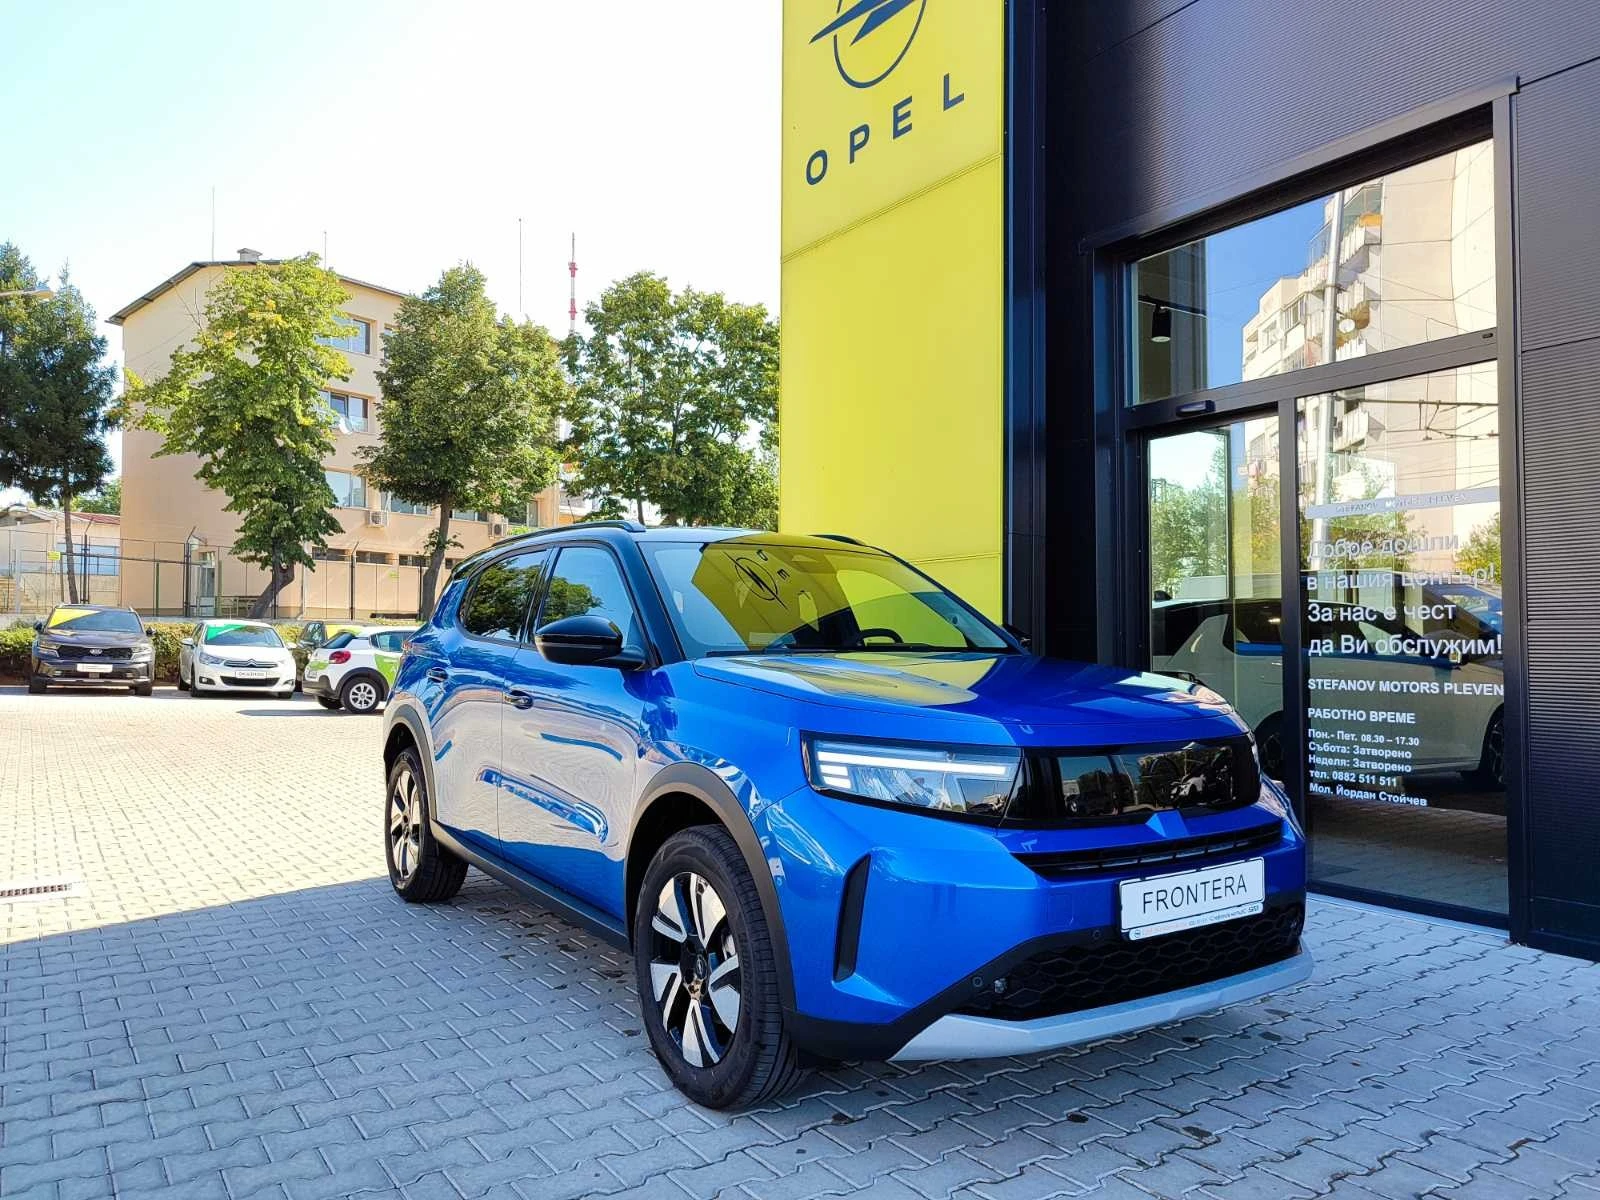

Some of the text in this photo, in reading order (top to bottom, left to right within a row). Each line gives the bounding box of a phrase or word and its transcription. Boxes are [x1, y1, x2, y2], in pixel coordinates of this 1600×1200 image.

[805, 72, 965, 185] OPEL
[1307, 535, 1459, 561] Добре дошли
[1307, 576, 1317, 590] в
[1325, 571, 1393, 590] нашия
[1308, 603, 1457, 622] За нас е чест
[1308, 633, 1502, 659] да Ви обслужим!
[1308, 678, 1504, 696] STEFANOV MOTORS PLEVEN
[1308, 707, 1416, 724] РАБОТНО ВРЕМЕ
[1337, 731, 1358, 741] Пет.
[1361, 734, 1385, 743] 08.30
[1395, 737, 1419, 746] 17.30
[1308, 742, 1412, 759] Събота: Затворено
[1308, 754, 1412, 772] Неделя: Затворено
[1309, 770, 1397, 787] тел. 0882 511 511
[1336, 784, 1376, 800] Йордан
[1379, 792, 1428, 806] Стойчев
[1143, 874, 1248, 914] FRONTERA
